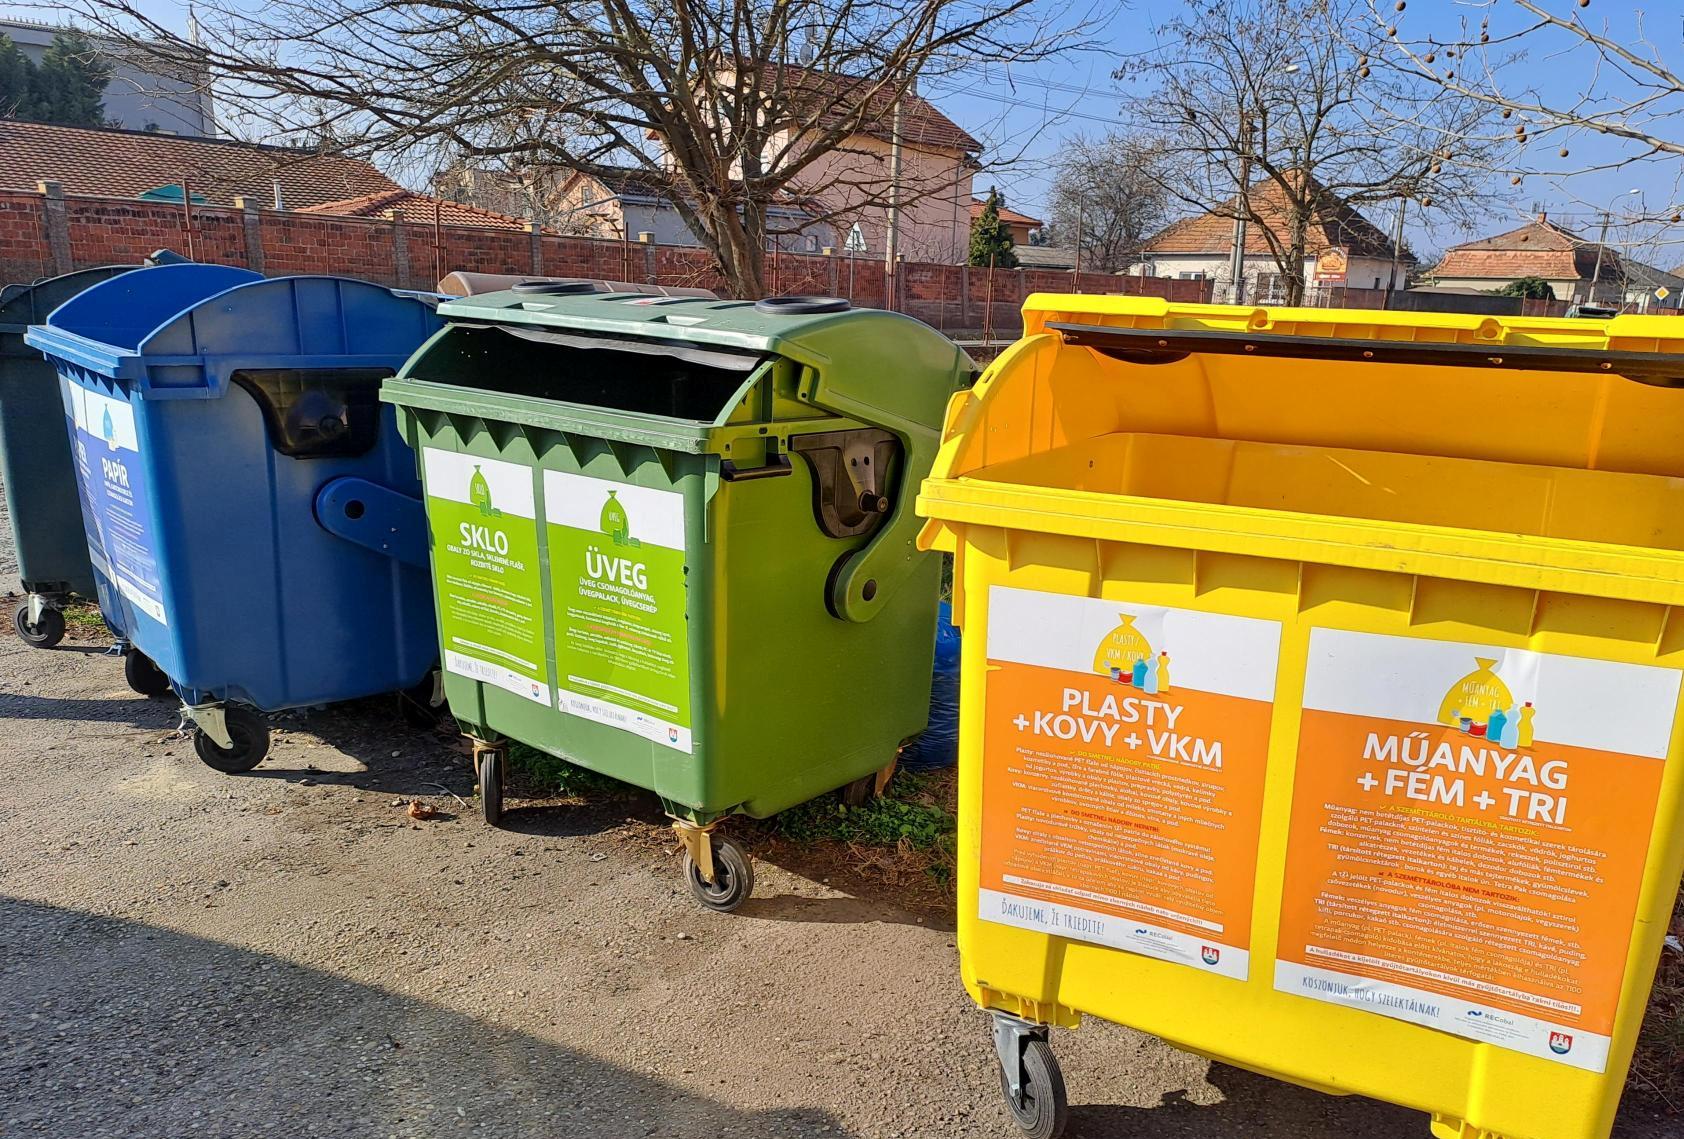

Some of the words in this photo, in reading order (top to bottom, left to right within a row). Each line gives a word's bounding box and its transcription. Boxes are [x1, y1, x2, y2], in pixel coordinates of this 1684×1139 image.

[101, 457, 130, 488] PAPÍR
[459, 521, 508, 555] SKLO
[585, 544, 648, 590] ÜVEG
[1062, 687, 1184, 730] PLASTY
[1034, 711, 1120, 747] KOVY
[1146, 728, 1223, 767] VKM
[1362, 731, 1570, 790] MŰANYAG
[1384, 765, 1466, 807] FÉM
[1502, 786, 1569, 825] TRI
[1001, 896, 1048, 924] ĎAKUJEME,
[1051, 907, 1059, 926] ŽE
[1063, 913, 1104, 936] TRIEDITE!
[1354, 986, 1375, 1003] HOGY
[1377, 989, 1440, 1018] SZELEKTÁLNAK!
